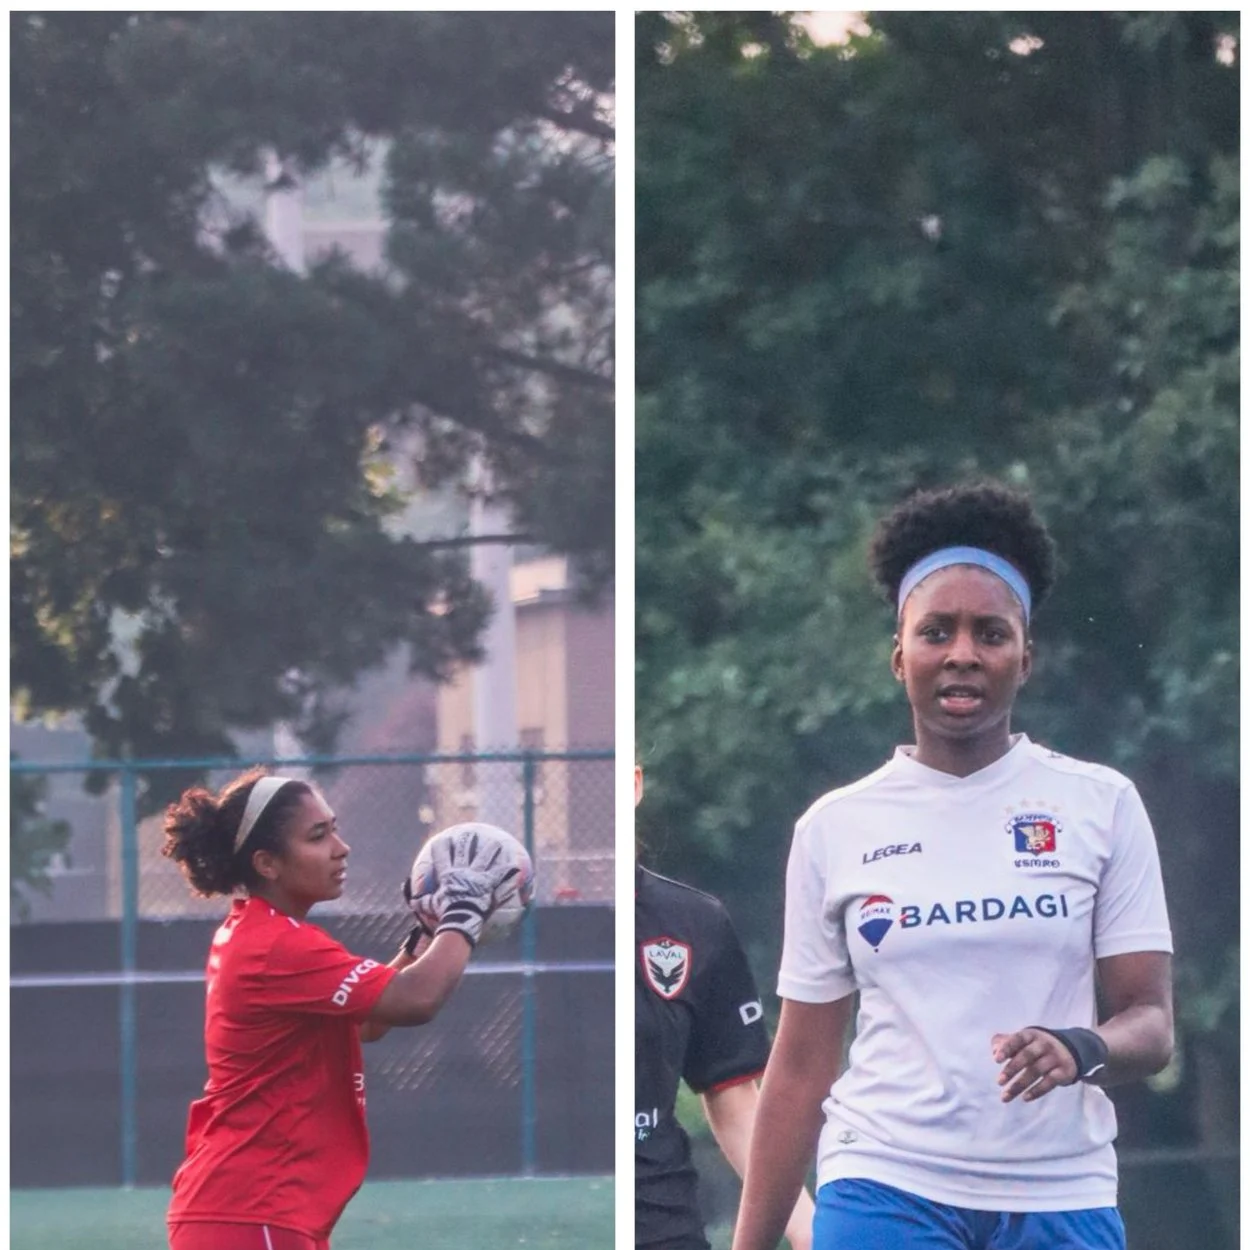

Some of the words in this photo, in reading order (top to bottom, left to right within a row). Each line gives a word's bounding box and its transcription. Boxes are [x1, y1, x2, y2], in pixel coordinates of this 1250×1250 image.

[863, 842, 922, 864] LEGEA
[901, 894, 1068, 929] BARDAGI
[332, 959, 379, 1006] DIVCO
